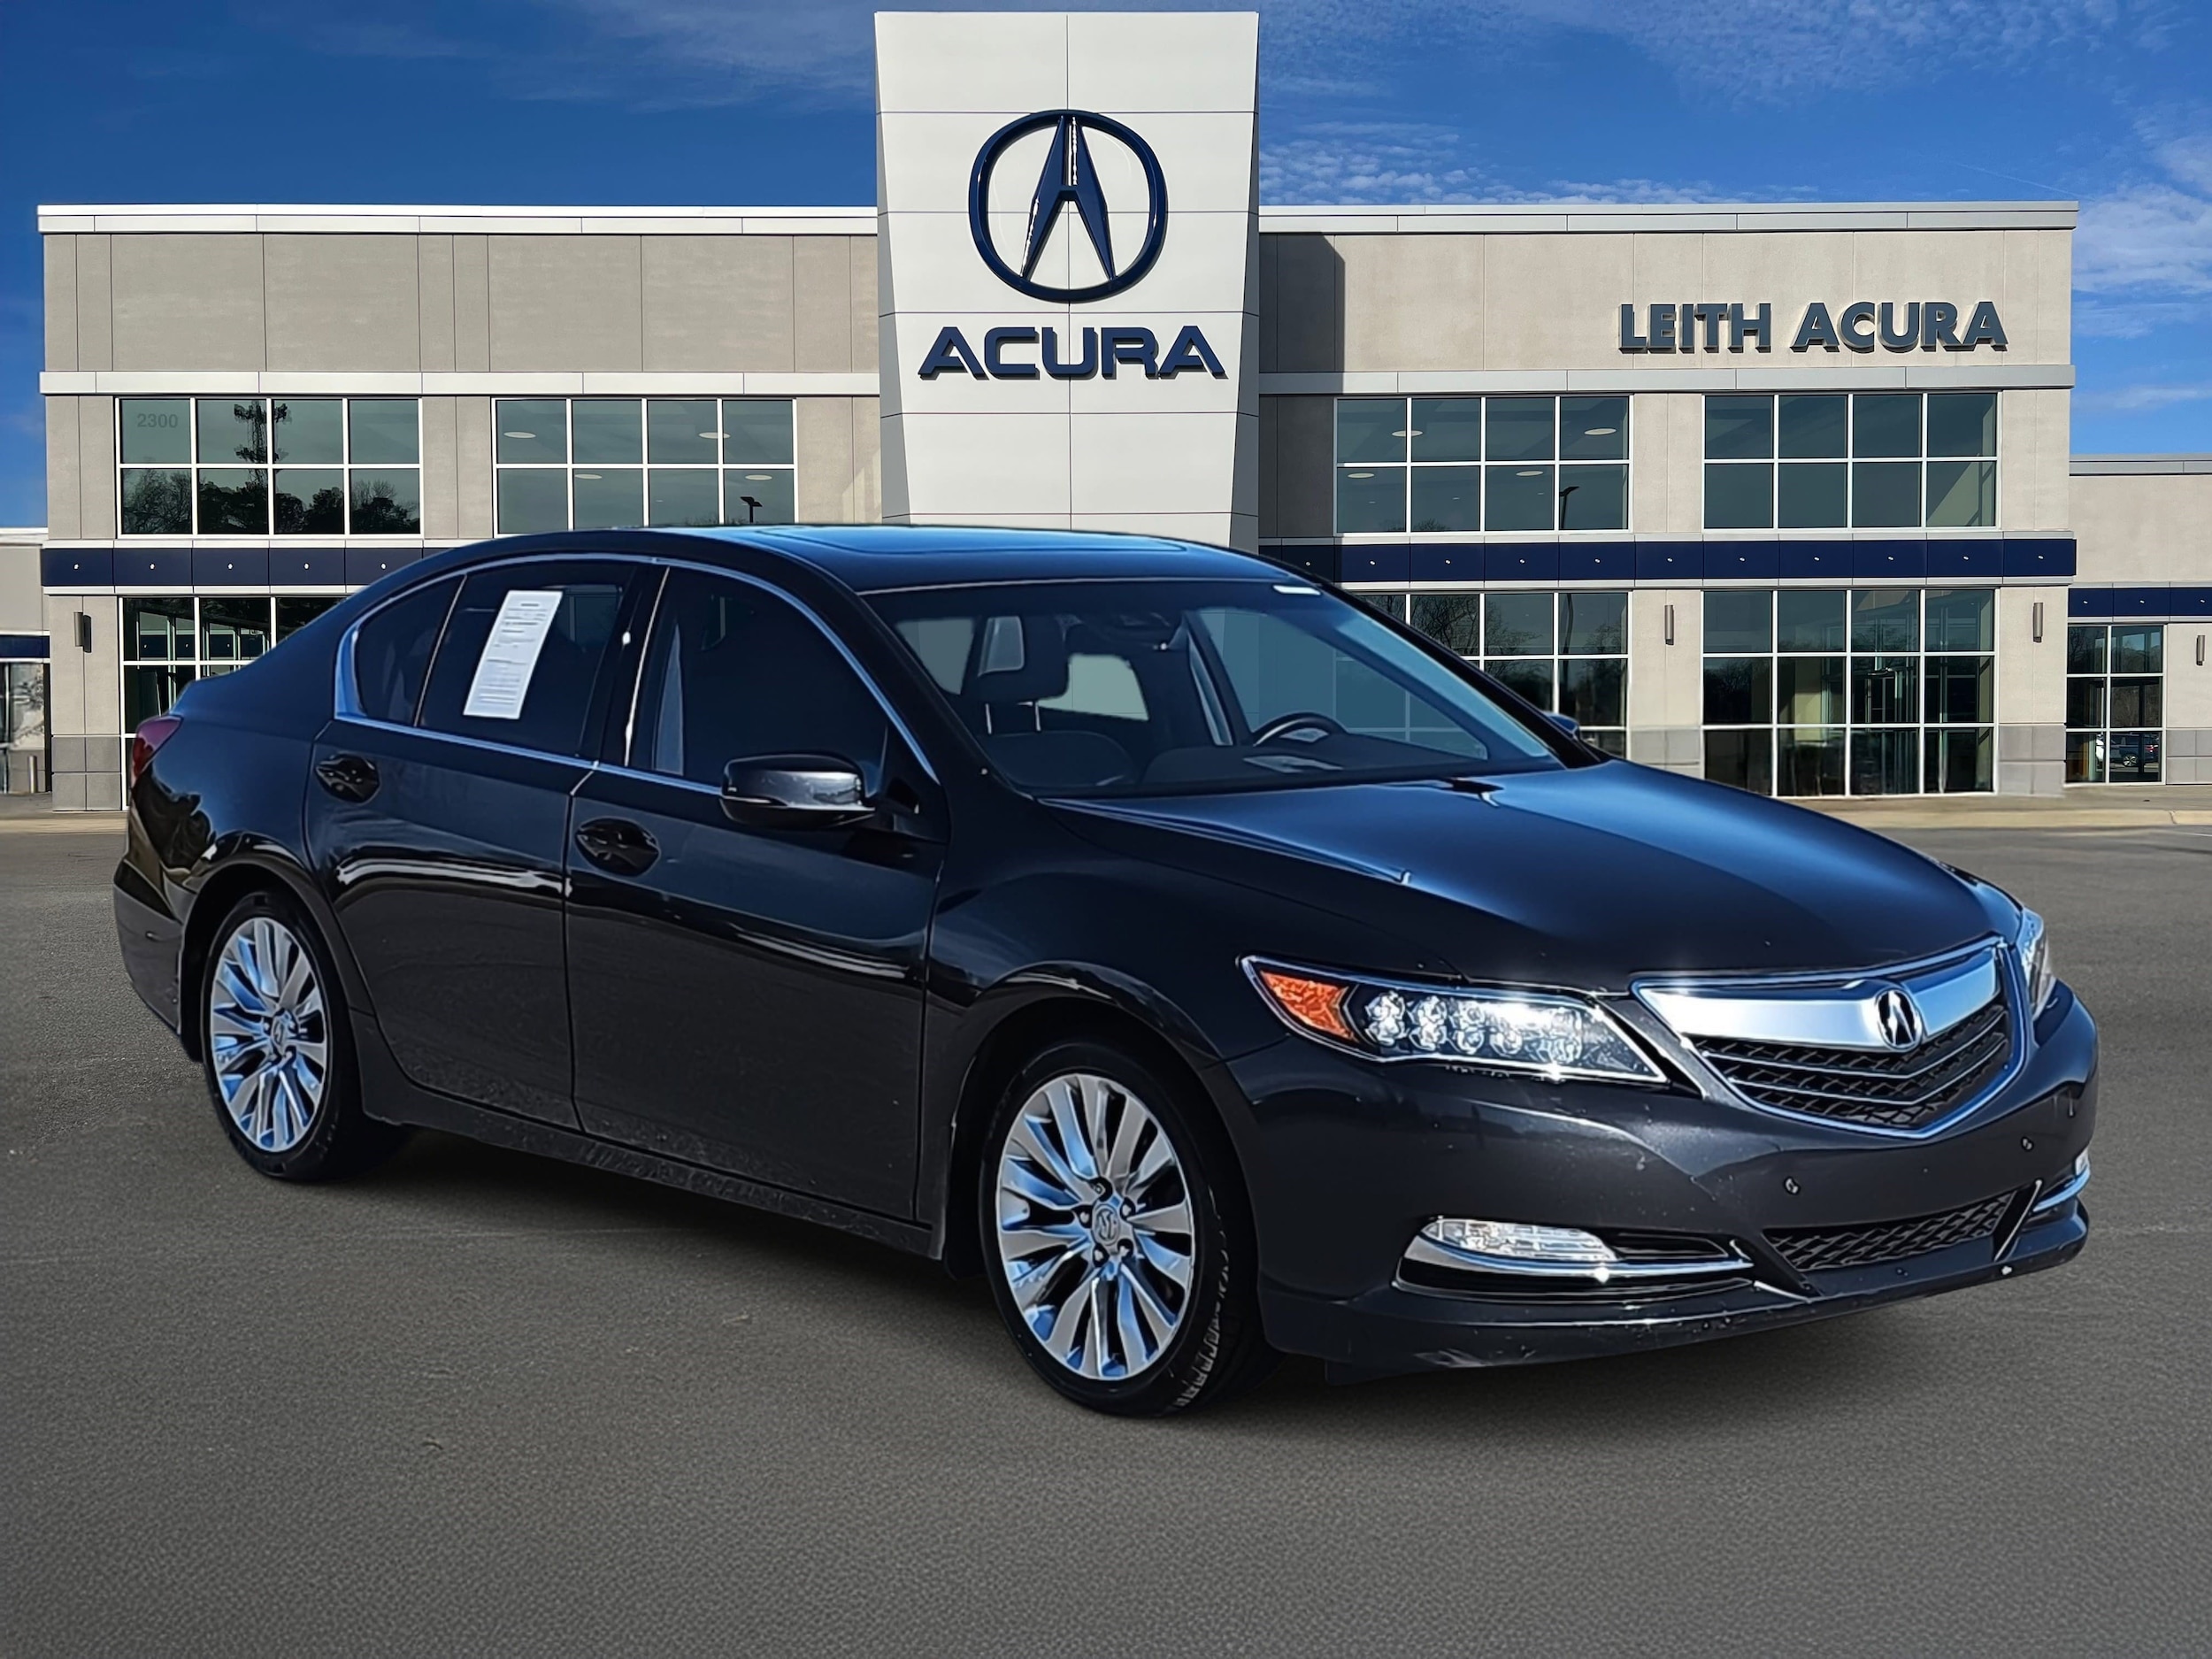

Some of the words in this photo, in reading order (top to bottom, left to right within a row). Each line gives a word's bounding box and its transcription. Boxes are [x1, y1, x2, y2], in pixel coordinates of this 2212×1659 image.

[918, 325, 1229, 380] ACURA
[1618, 303, 1771, 354] LEITH
[1789, 301, 2008, 354] ACURA
[137, 413, 178, 428] 2300
